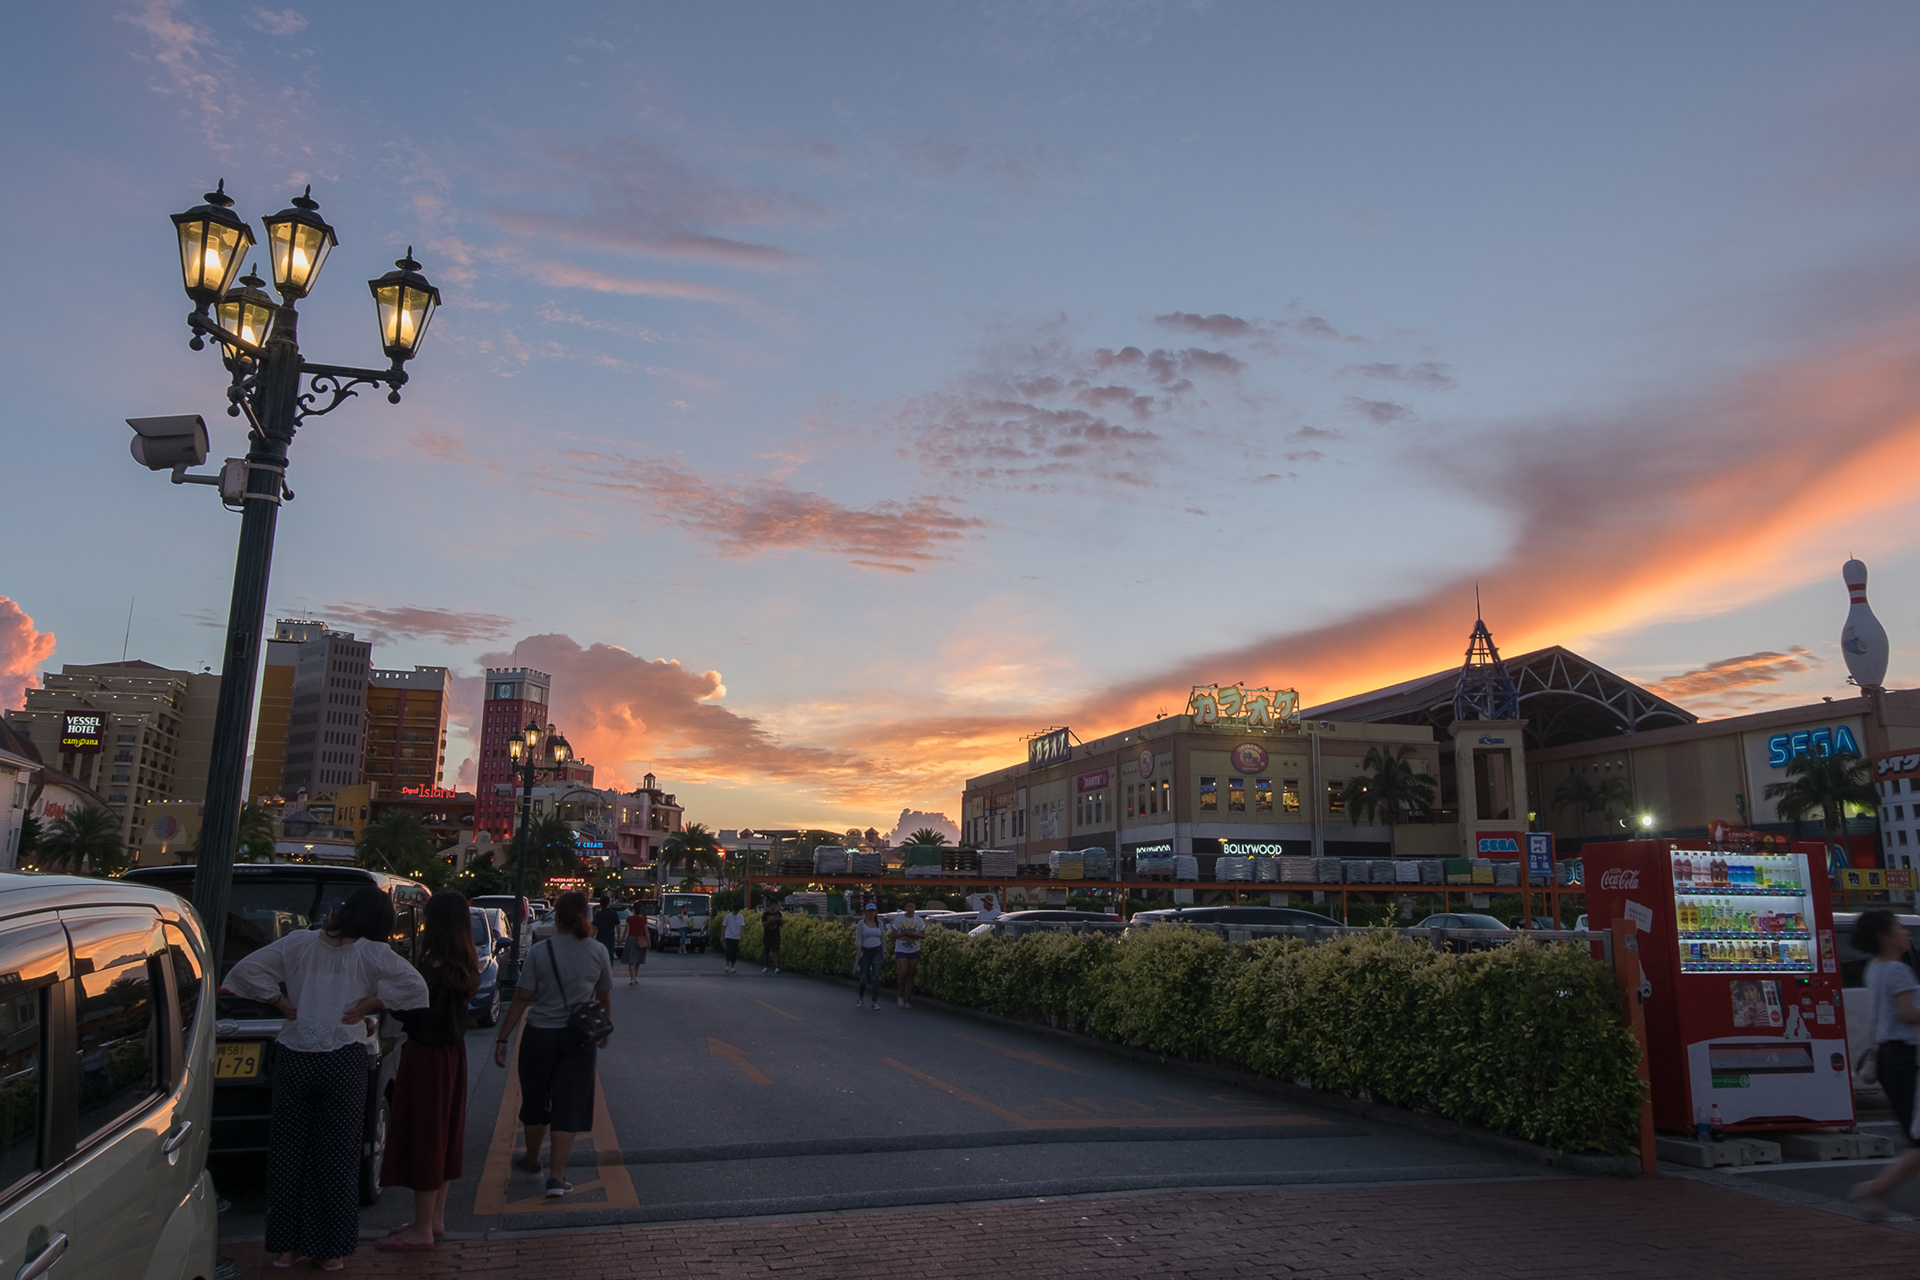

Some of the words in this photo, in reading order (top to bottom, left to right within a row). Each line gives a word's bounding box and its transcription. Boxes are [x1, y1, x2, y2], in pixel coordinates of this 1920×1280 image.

[1191, 686, 1297, 725] カラオケ
[66, 716, 101, 726] VESSEL
[67, 725, 96, 734] HOTEL
[62, 738, 98, 748] campana
[1768, 726, 1862, 767] SEGA
[419, 783, 456, 798] Island
[1223, 844, 1282, 855] BOLLYWOOD
[1479, 838, 1519, 852] SEGA
[1600, 869, 1640, 890] Coca-Cola
[215, 1056, 256, 1076] 1-79
